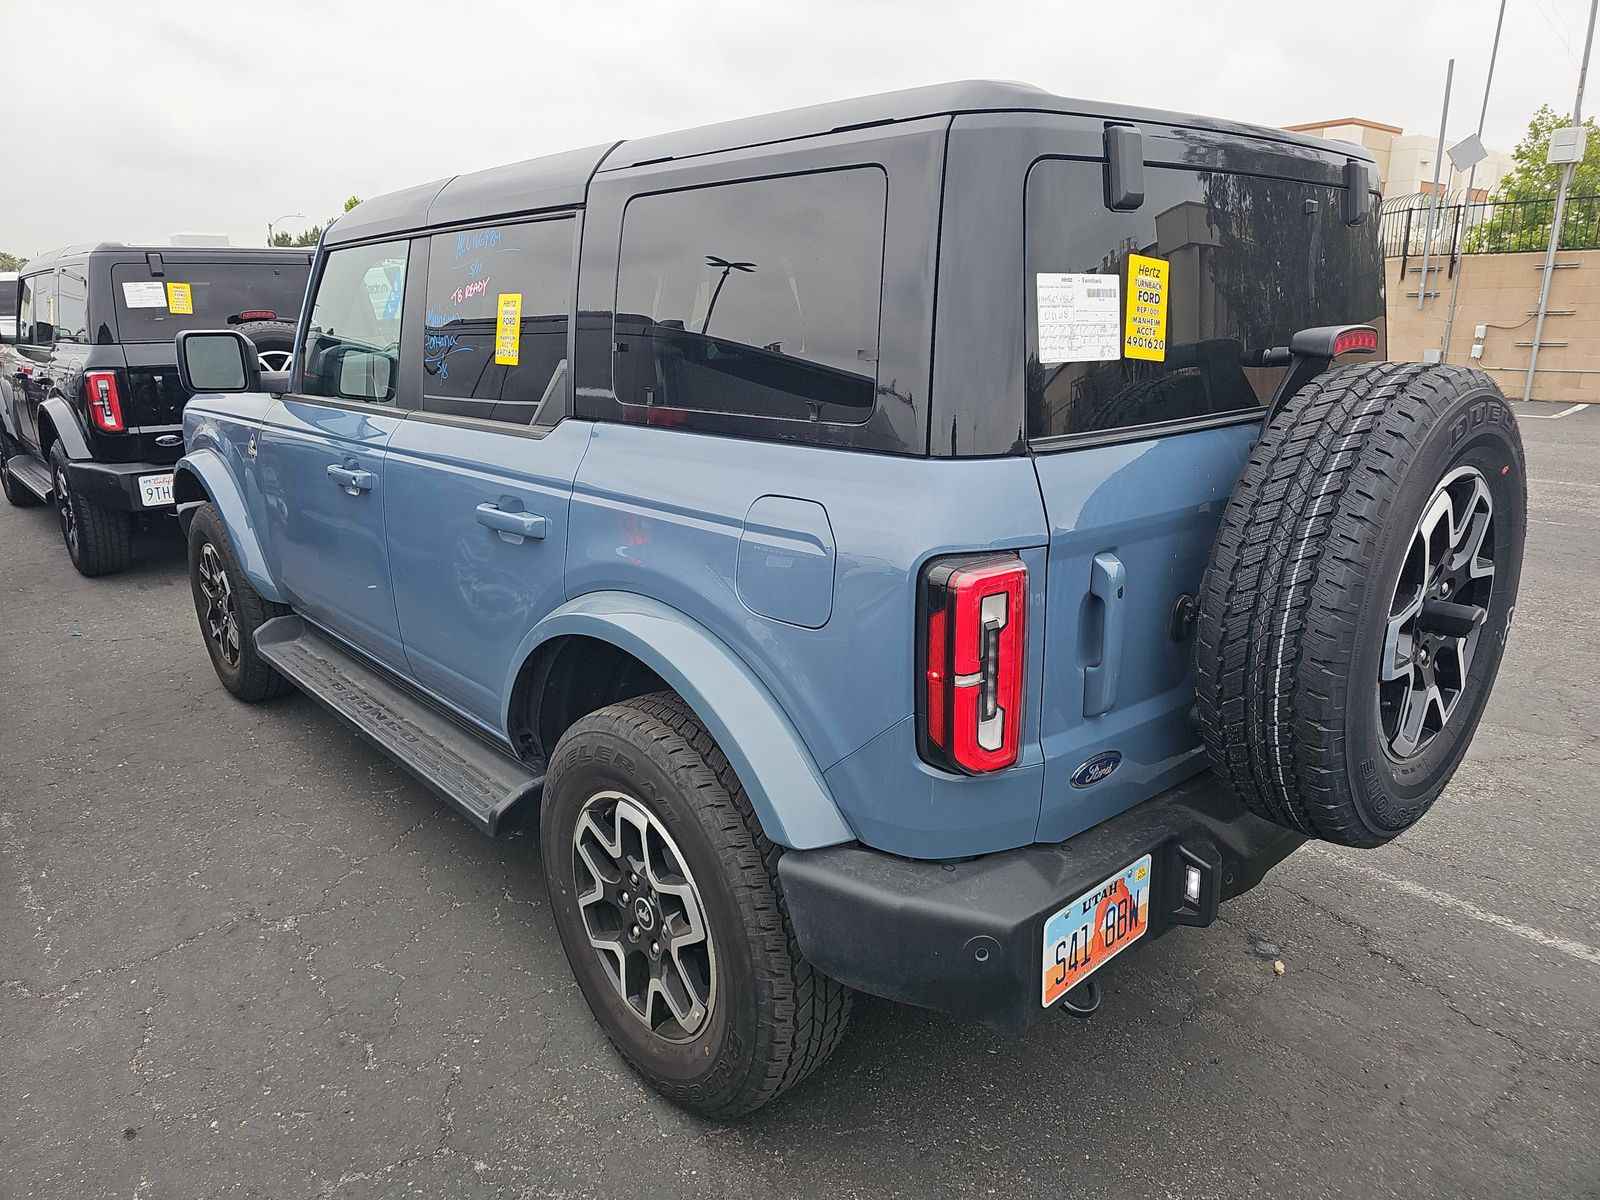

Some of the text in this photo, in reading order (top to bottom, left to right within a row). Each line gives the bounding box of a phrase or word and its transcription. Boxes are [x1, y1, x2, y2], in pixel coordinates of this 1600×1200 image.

[1138, 263, 1161, 279] Hertz
[465, 276, 491, 299] READY
[1135, 279, 1163, 291] TURNBACK
[1138, 290, 1161, 305] FORD
[1132, 316, 1161, 327] MANHEIM
[1126, 336, 1165, 350] 4901620
[1081, 880, 1119, 916] UTAH
[1055, 924, 1091, 985] S41
